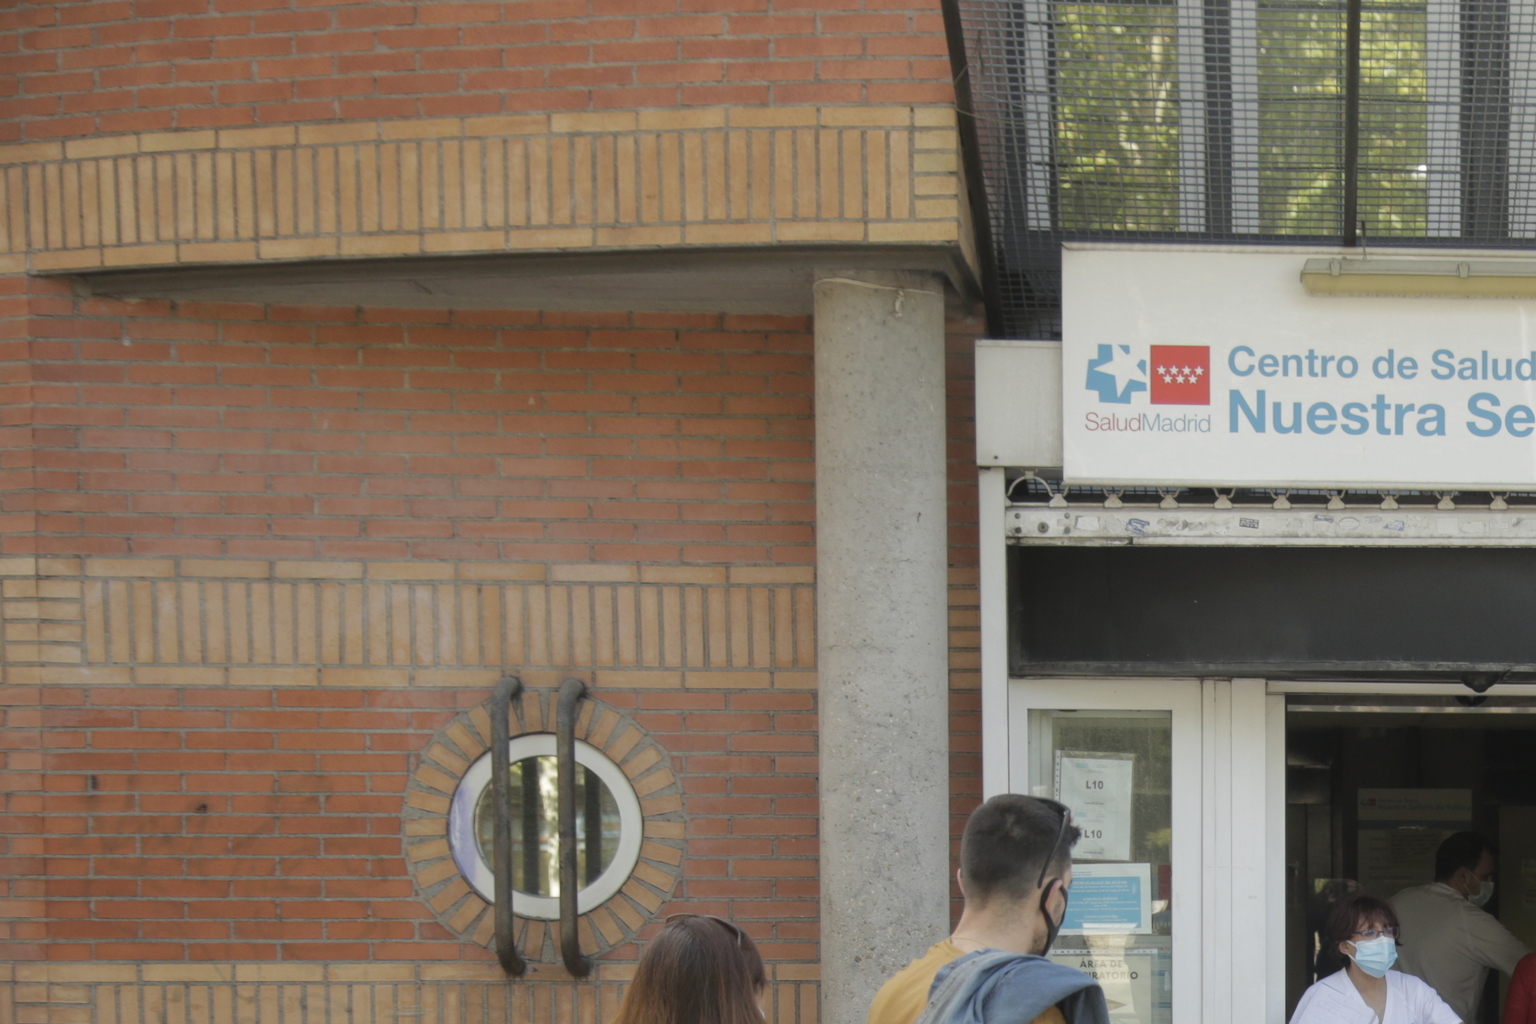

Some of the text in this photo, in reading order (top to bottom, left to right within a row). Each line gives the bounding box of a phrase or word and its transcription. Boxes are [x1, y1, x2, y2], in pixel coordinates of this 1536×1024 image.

[1228, 345, 1359, 379] Centro
[1372, 349, 1419, 380] de
[1229, 389, 1446, 437] Nuestra
[1085, 411, 1211, 433] SaludMadrid
[1085, 780, 1104, 790] L10
[1084, 829, 1102, 839] L10
[1079, 957, 1122, 968] ÁREA DE
